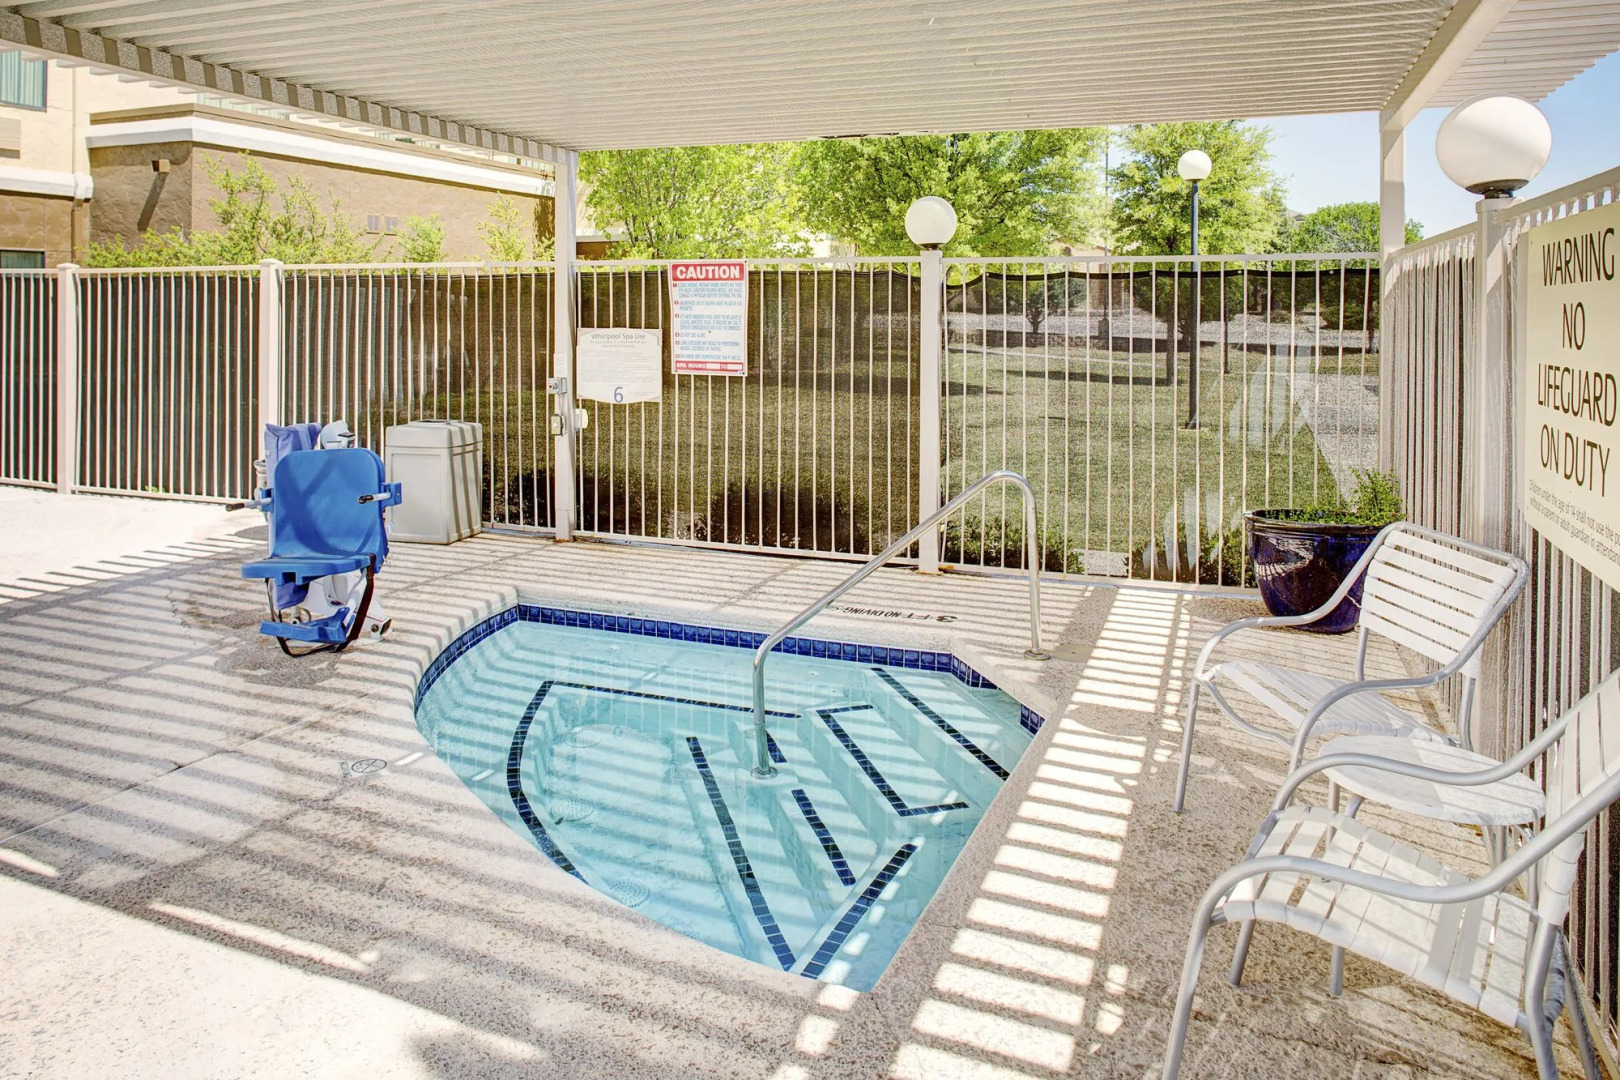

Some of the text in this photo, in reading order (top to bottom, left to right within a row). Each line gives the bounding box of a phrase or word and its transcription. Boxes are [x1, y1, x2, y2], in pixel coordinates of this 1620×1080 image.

[676, 265, 740, 279] CAUTION
[1543, 227, 1614, 286] WARNING
[1562, 301, 1586, 351] NO
[613, 386, 624, 403] 6
[1538, 363, 1617, 427] LIFEGUARD
[1540, 423, 1610, 497] ON DUTY
[1595, 521, 1604, 536] use
[1605, 523, 1614, 542] the
[843, 606, 958, 623] 3 FT NO DIVING
